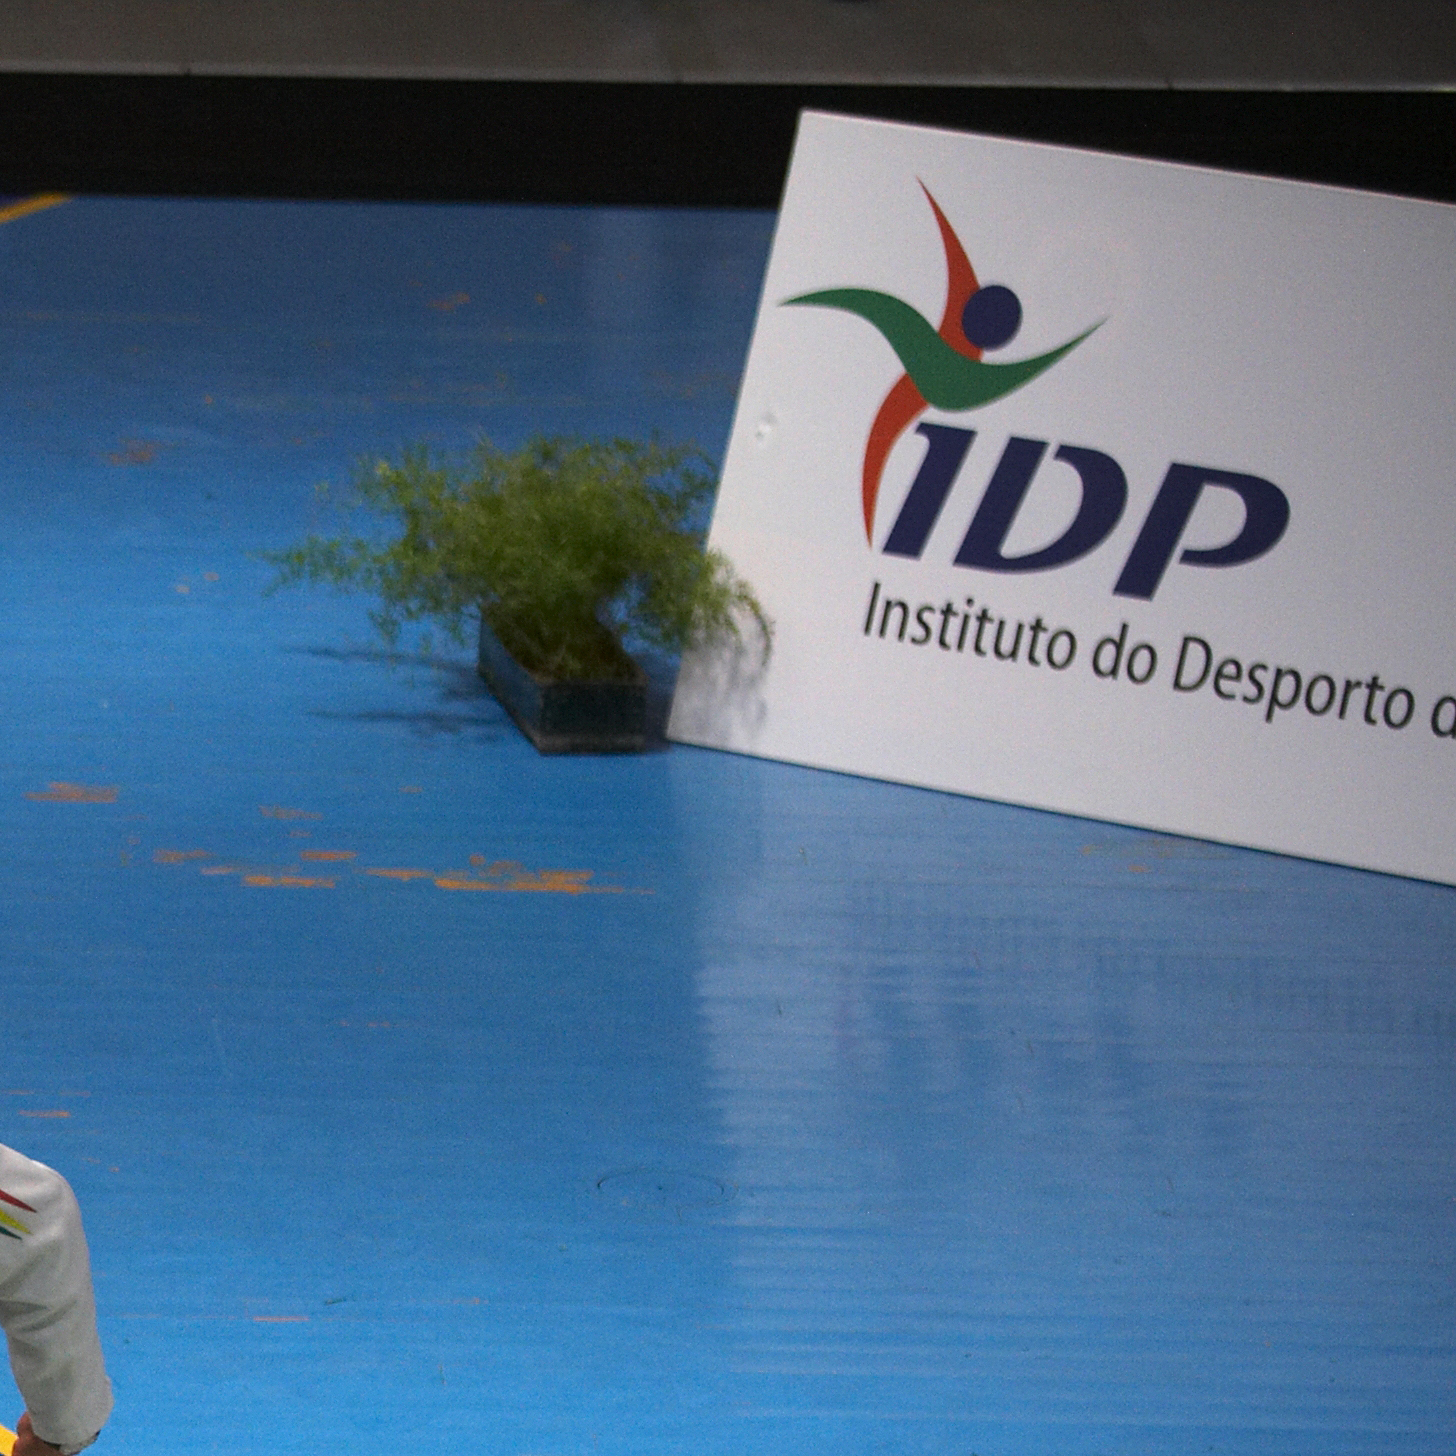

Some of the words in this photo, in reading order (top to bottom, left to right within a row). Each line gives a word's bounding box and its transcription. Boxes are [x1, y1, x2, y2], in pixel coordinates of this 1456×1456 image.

[883, 421, 1291, 600] IDP
[862, 581, 1078, 672] Instituto
[1091, 622, 1158, 686] do
[1172, 634, 1416, 730] Desporto
